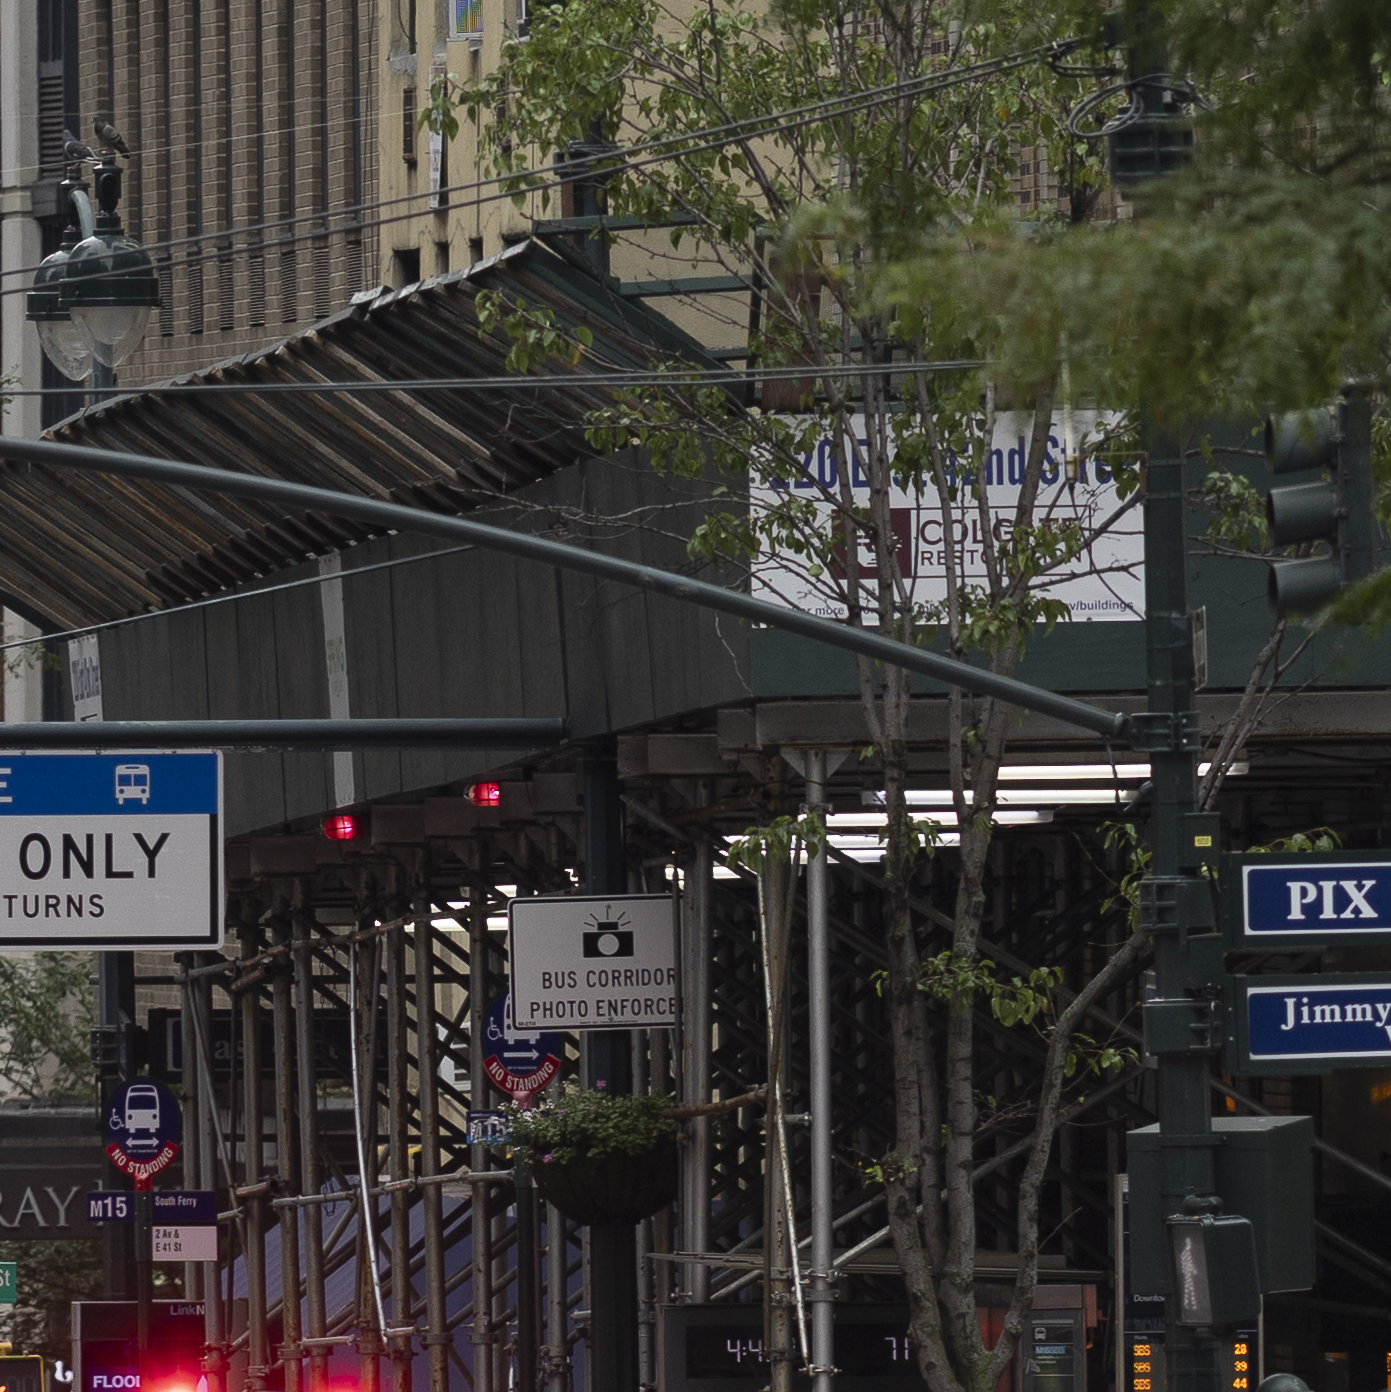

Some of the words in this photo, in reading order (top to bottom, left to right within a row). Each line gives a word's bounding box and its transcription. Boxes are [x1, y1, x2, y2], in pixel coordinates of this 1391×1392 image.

[921, 517, 1082, 546] COLG
[19, 831, 171, 881] ONLY
[2, 893, 105, 919] TURNS
[1286, 879, 1378, 920] PIX
[542, 970, 578, 990] BUS
[586, 967, 676, 988] CORRIDOR
[530, 1000, 589, 1020] PHOTO
[1280, 997, 1391, 1031] Jimmy
[489, 1061, 504, 1082] NO
[505, 1061, 555, 1091] STANDING
[111, 1148, 127, 1167] NO
[127, 1147, 174, 1176] STANDING
[90, 1196, 128, 1218] M15
[155, 1196, 176, 1206] South
[178, 1196, 197, 1207] Ferry
[155, 1228, 161, 1239] 2
[162, 1228, 173, 1239] Av
[163, 1242, 172, 1252] 41
[174, 1242, 183, 1252] St
